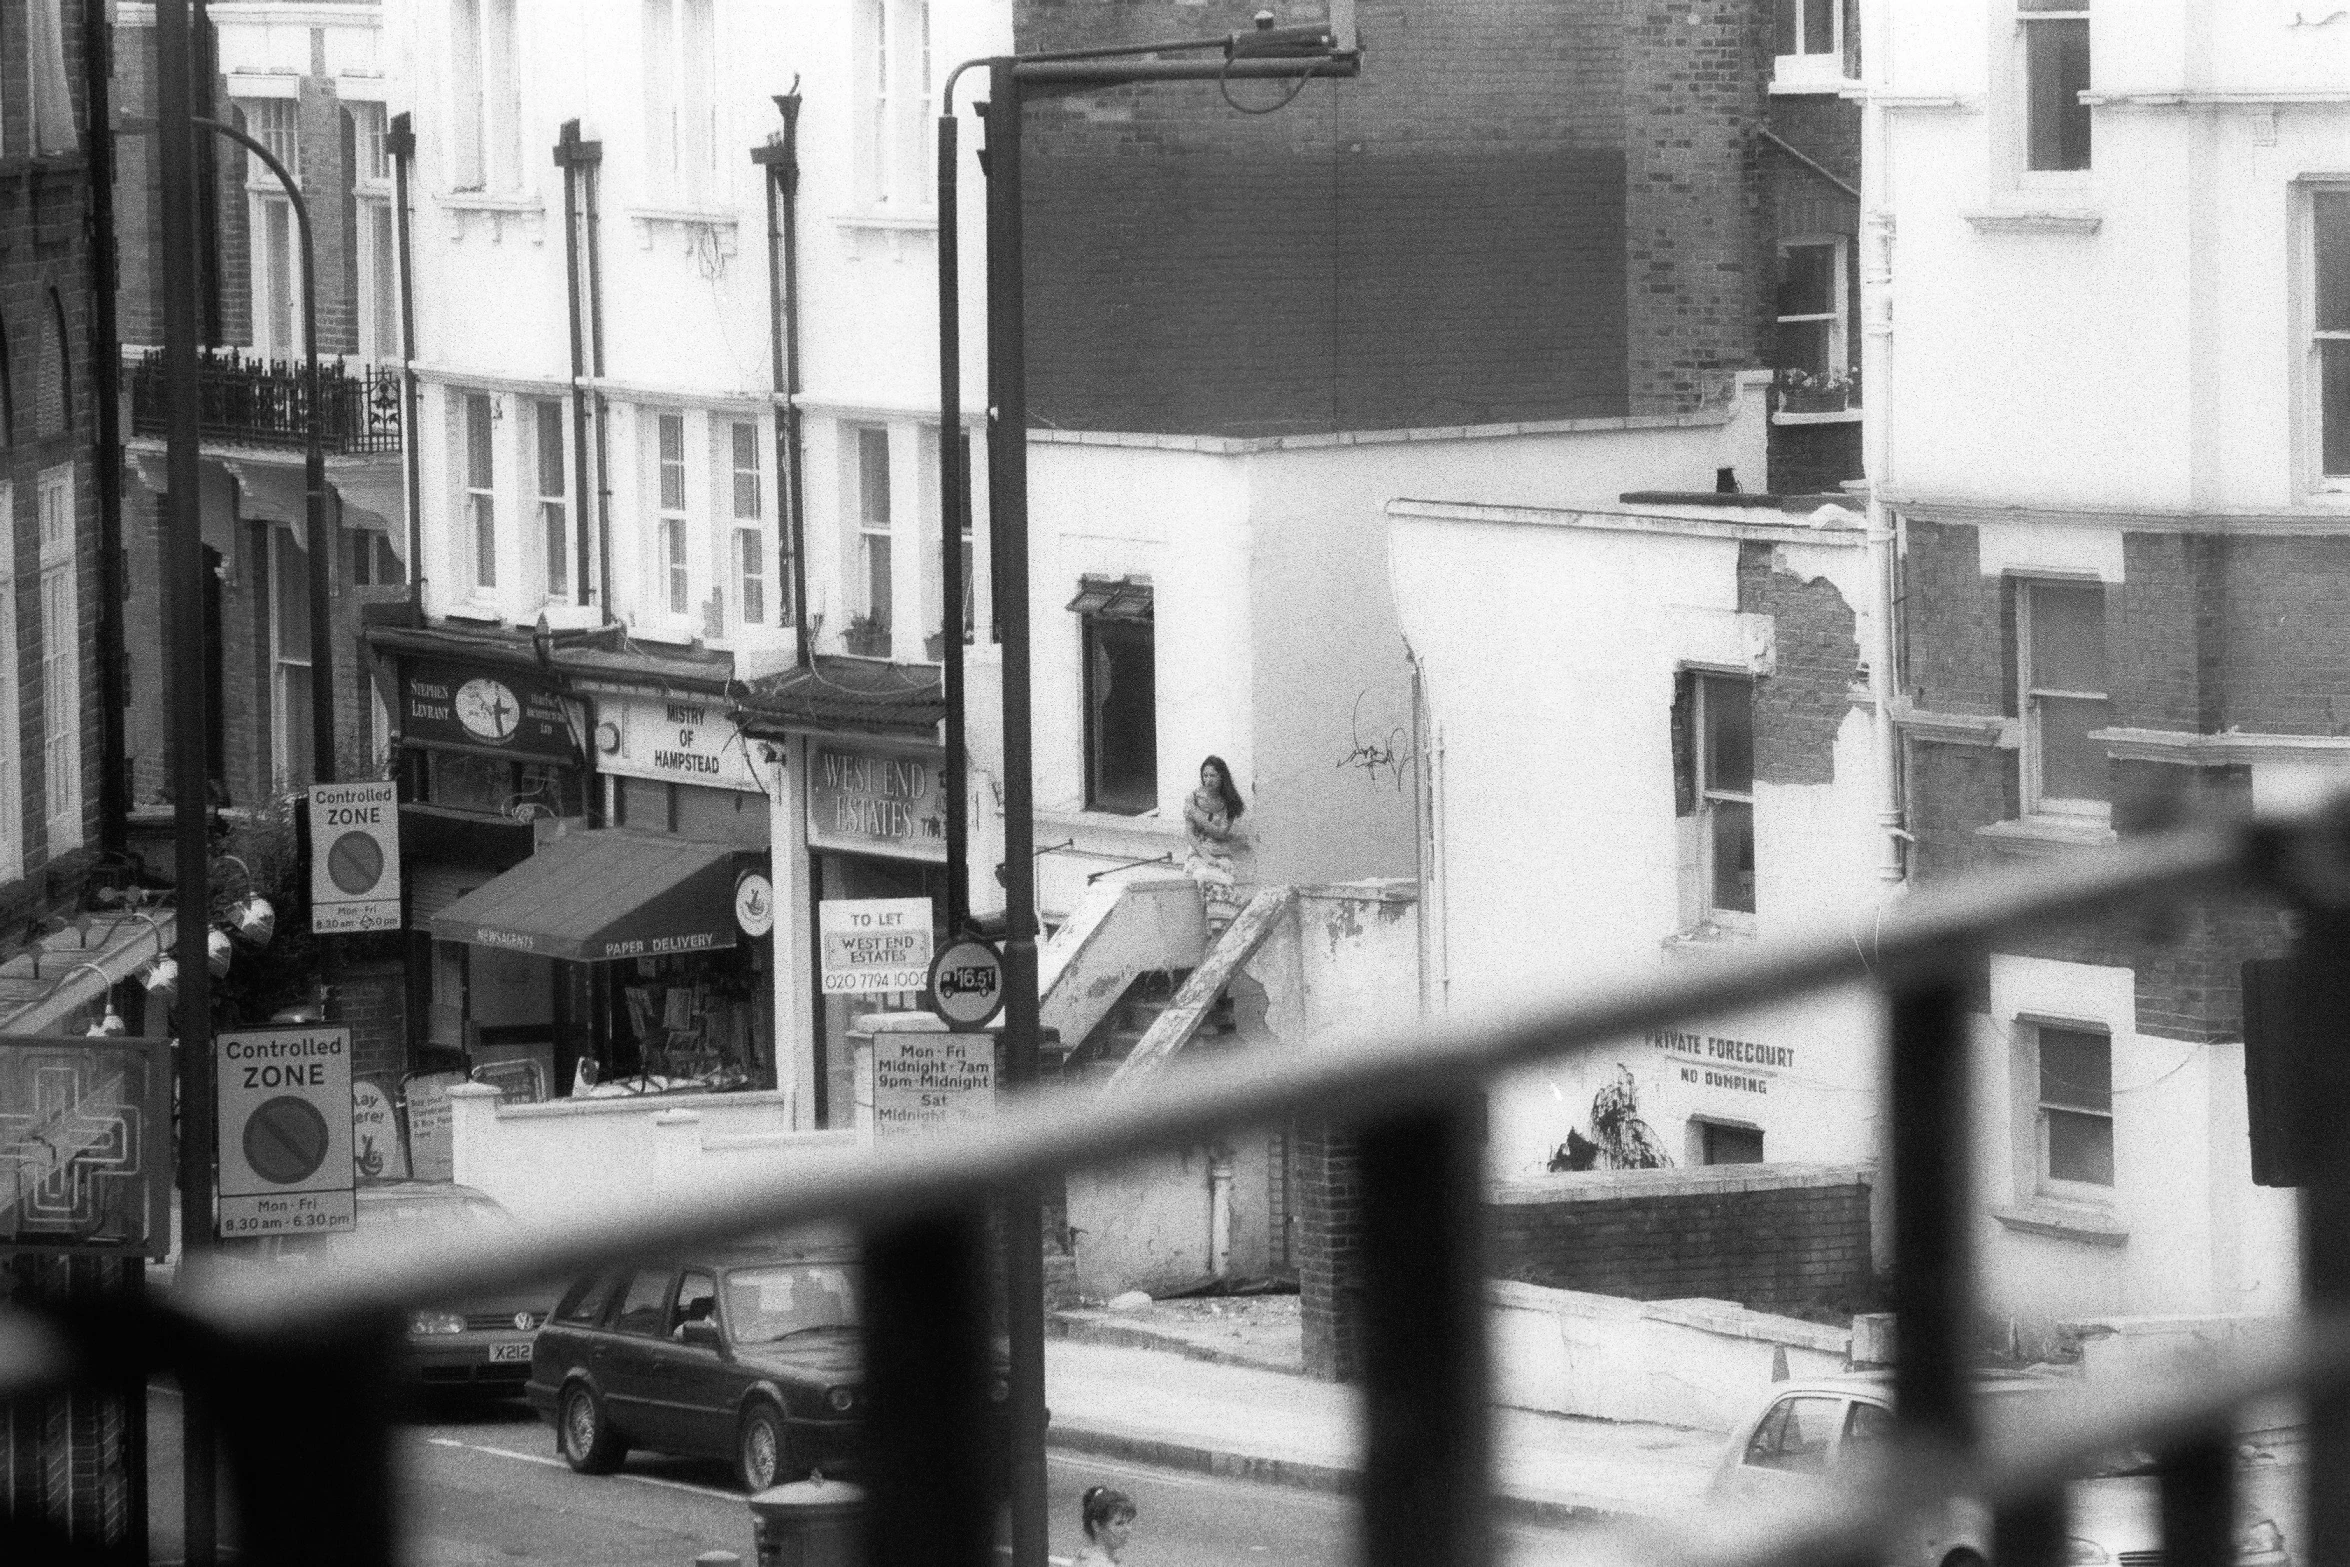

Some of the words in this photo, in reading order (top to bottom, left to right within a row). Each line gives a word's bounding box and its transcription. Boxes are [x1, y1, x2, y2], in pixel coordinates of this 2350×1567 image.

[666, 704, 705, 726] MISTRY
[679, 729, 694, 748] OF
[654, 749, 720, 774] HAMPSTEAD
[824, 753, 876, 793] WEST
[883, 760, 926, 799] END
[315, 787, 393, 805] Controlled
[327, 807, 381, 826] ZONE
[836, 795, 913, 838] ESTATES
[852, 914, 872, 927] TO
[878, 913, 902, 926] LET
[605, 941, 644, 957] PAPER
[652, 933, 714, 953] DELIVERY
[842, 937, 882, 950] WEST
[885, 935, 915, 950] END
[850, 951, 907, 965] ESTATES
[825, 974, 857, 990] 020
[860, 972, 889, 988] 7794
[226, 1037, 342, 1060] Controlled
[901, 1044, 934, 1059] Mon
[946, 1044, 966, 1058] Fri
[1707, 1036, 1795, 1068] FORECOURT
[243, 1063, 325, 1089] ZONE
[879, 1060, 946, 1074] Midnight
[959, 1060, 990, 1073] 7am
[1680, 1067, 1698, 1083] NO
[1704, 1070, 1767, 1095] DUMPING
[921, 1094, 947, 1107] Sat
[258, 1201, 288, 1213] Mon
[299, 1199, 317, 1210] Fri
[262, 1219, 283, 1229] am
[329, 1214, 350, 1228] pm
[495, 1344, 531, 1360] X212
